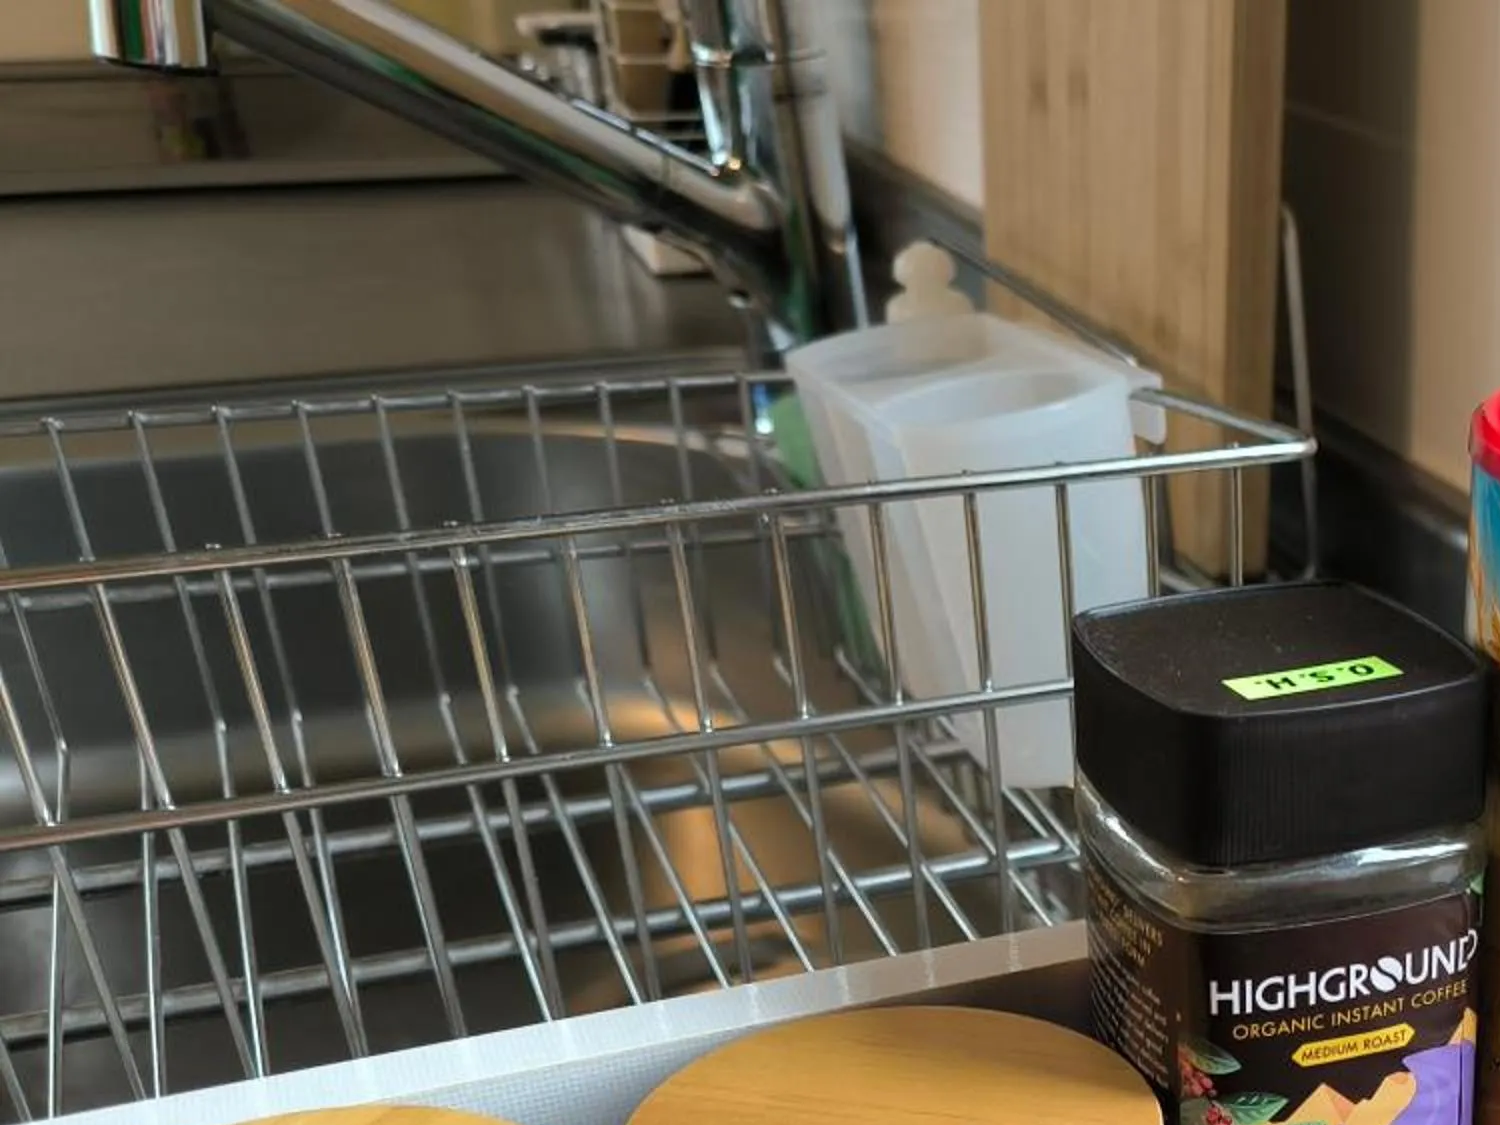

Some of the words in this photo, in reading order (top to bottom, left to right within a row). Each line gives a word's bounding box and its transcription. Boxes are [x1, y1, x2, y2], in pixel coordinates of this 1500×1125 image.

[1232, 1013, 1326, 1041] ORGANIC
[1331, 997, 1405, 1027] INSTANT
[1411, 978, 1470, 1010] COFFEE
[1301, 1041, 1360, 1062] MEDIUM
[1363, 1029, 1409, 1050] ROAST
